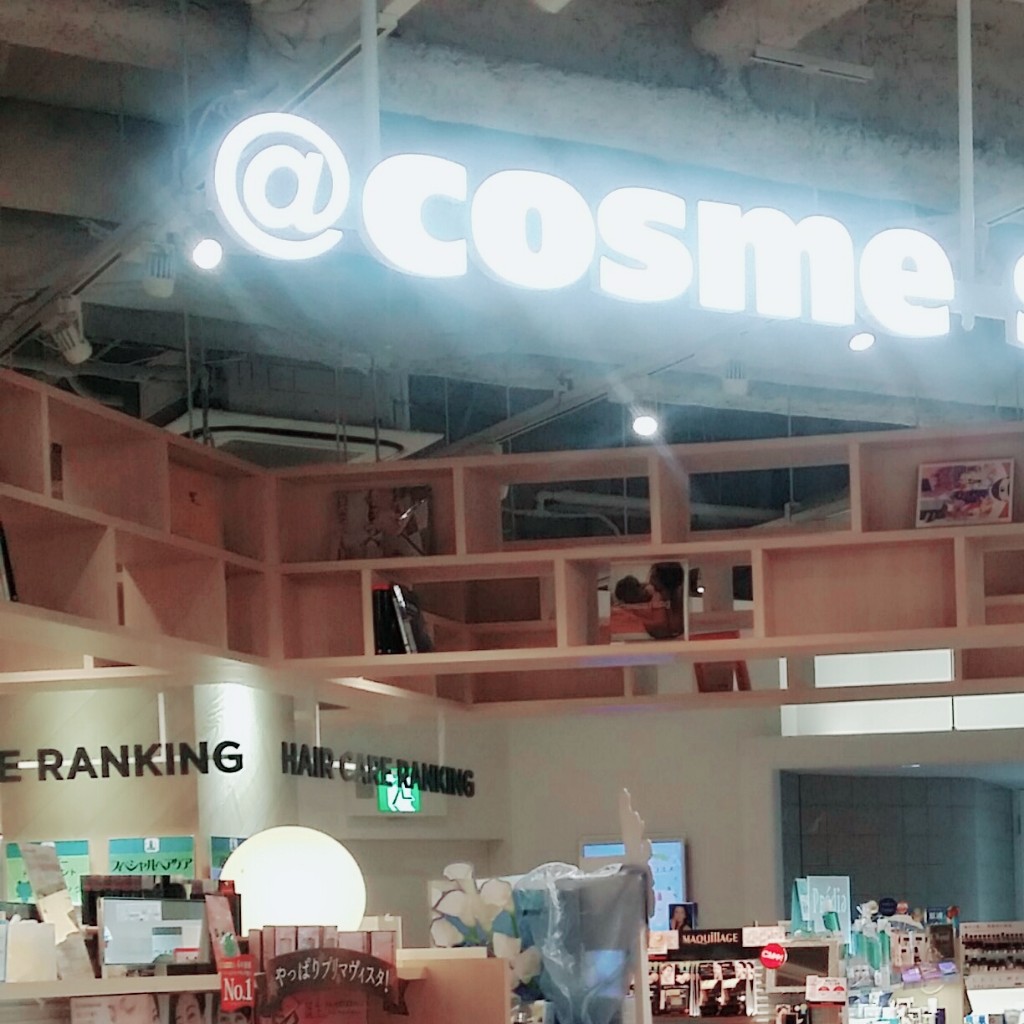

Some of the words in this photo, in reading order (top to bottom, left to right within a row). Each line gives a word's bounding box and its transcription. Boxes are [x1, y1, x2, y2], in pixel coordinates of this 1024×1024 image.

[212, 112, 955, 337] @cosme
[37, 741, 243, 781] RANKING
[281, 741, 334, 779] HAIR
[396, 759, 475, 798] RANKING
[223, 978, 253, 1001] No.1
